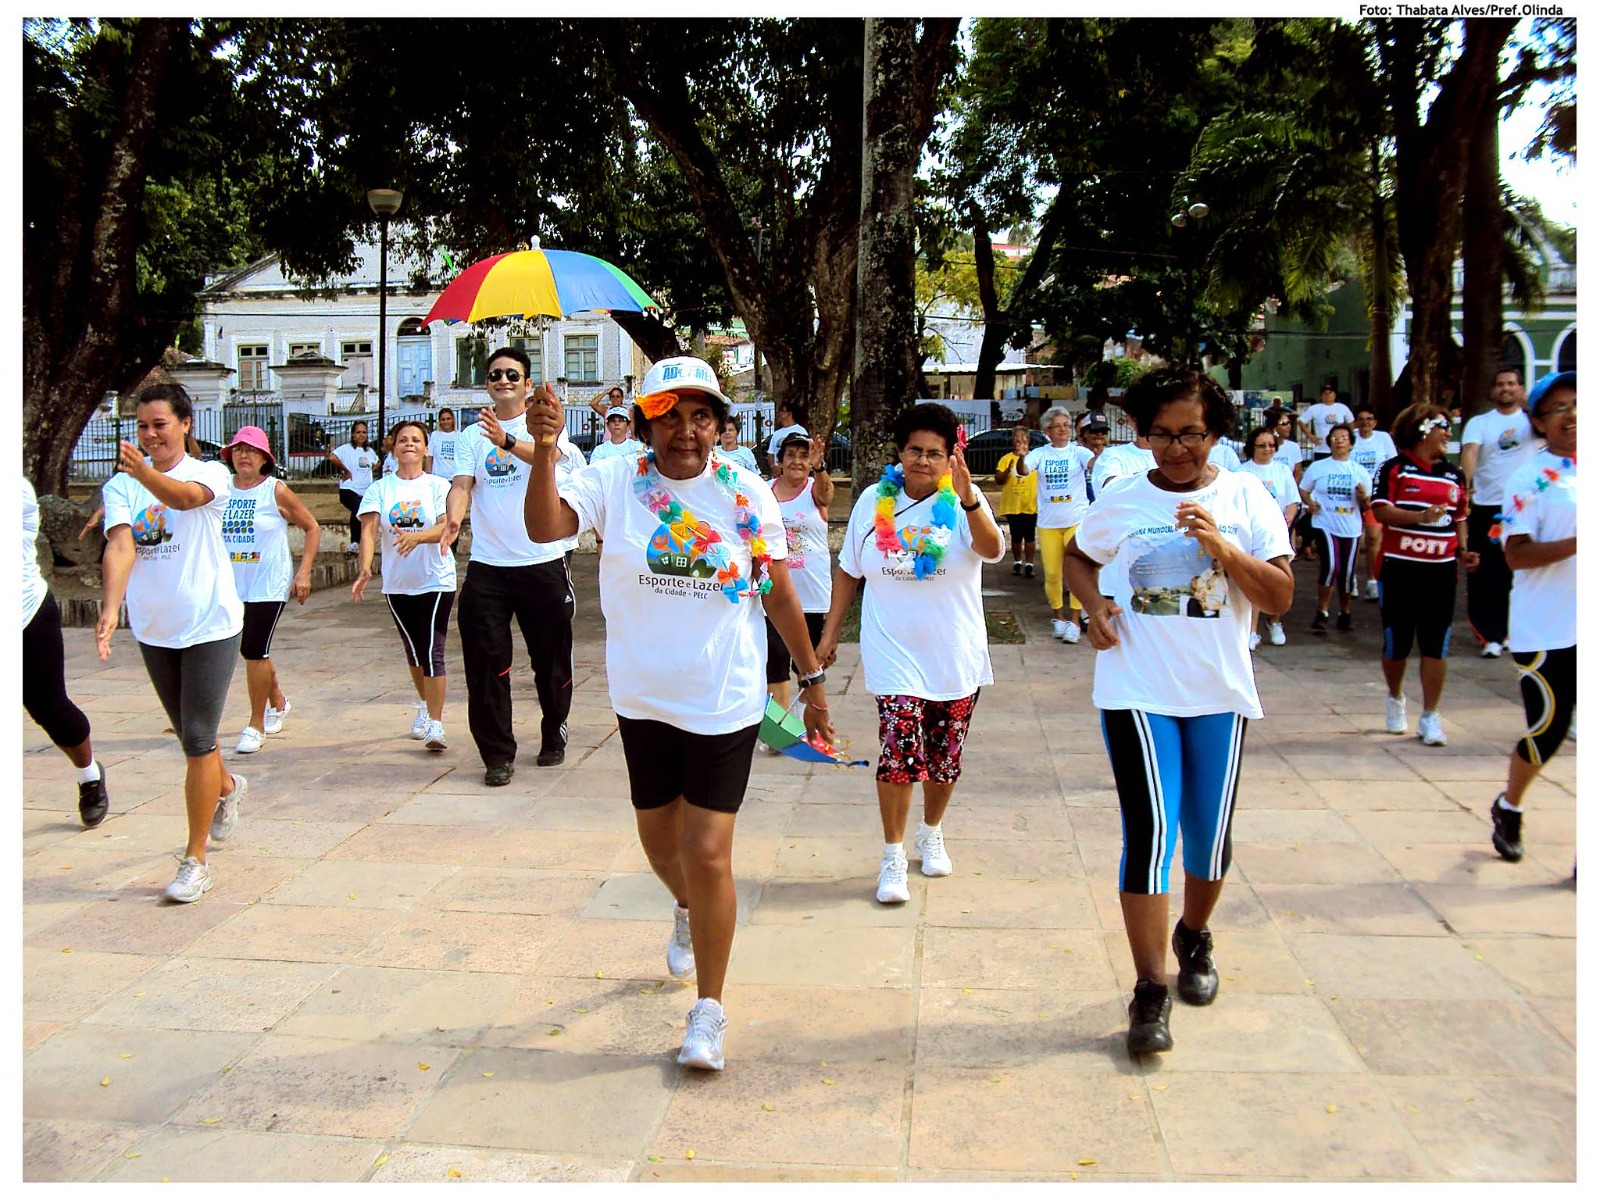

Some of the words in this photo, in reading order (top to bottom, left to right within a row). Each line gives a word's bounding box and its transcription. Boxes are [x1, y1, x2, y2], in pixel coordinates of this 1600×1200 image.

[228, 509, 255, 520] LAZER
[1147, 525, 1174, 534] MUNDIAL
[232, 534, 255, 543] CIDADE
[1400, 536, 1449, 555] POTY
[639, 574, 685, 588] Esporte
[665, 588, 687, 597] Cidade
[694, 592, 708, 600] PELC
